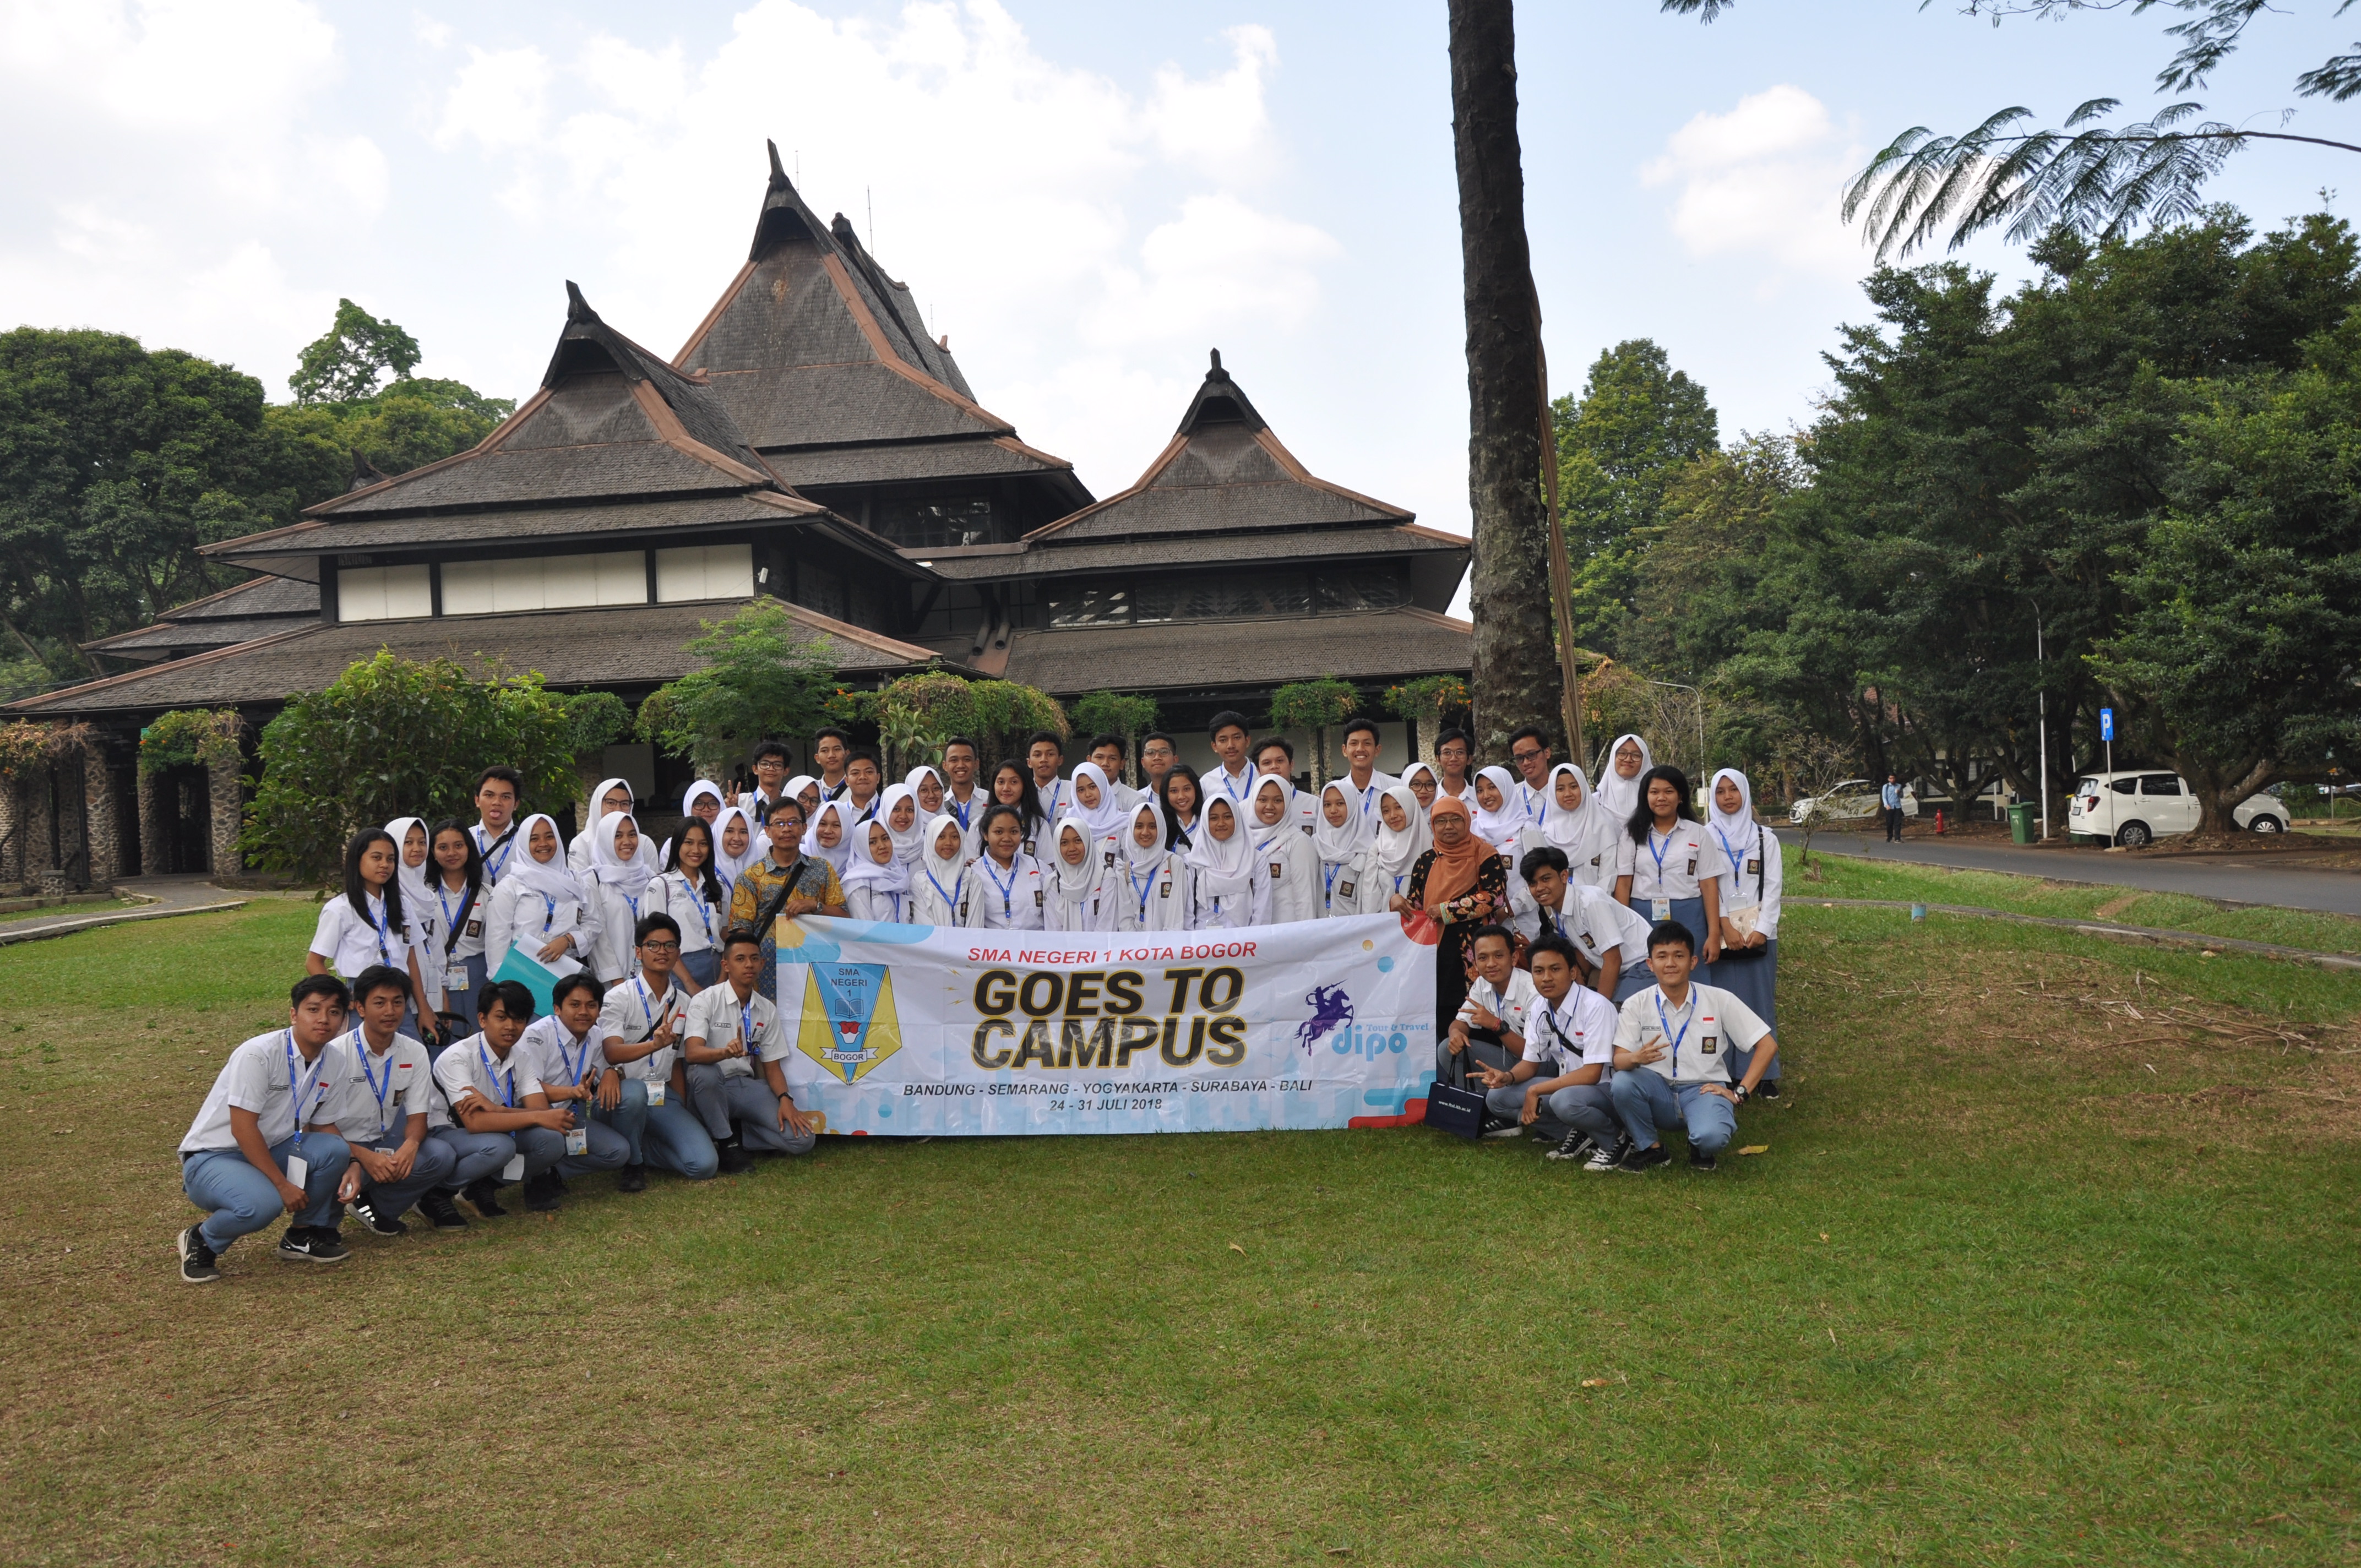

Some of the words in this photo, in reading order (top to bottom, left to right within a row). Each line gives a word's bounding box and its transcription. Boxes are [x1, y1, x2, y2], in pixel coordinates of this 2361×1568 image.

[2102, 714, 2110, 736] P
[967, 948, 1011, 962] SMA
[1018, 950, 1097, 964] NEGERI
[1103, 950, 1112, 962] 1
[1119, 947, 1174, 961] KOTA
[1180, 942, 1257, 959] BOGOR
[839, 968, 859, 976] SMA
[831, 978, 867, 987] NEGERI
[973, 969, 1145, 1017] GOES
[1163, 966, 1245, 1015] TO
[1366, 1023, 1389, 1032] Tour
[1400, 1023, 1429, 1031] Travel
[971, 1015, 1248, 1071] CAMPUS
[1331, 1025, 1407, 1061] dipo
[834, 1053, 864, 1061] BOGOR
[904, 1085, 975, 1096] BANDUNG
[988, 1084, 1069, 1095] SEMARANG
[1083, 1082, 1178, 1094] YOGYAKARTA
[1191, 1081, 1267, 1092] SURABAYA
[1280, 1080, 1313, 1091] BALI
[1049, 1100, 1065, 1111] 24
[1078, 1099, 1092, 1110] 31
[1097, 1099, 1128, 1110] JULI
[1131, 1098, 1162, 1110] 2018
